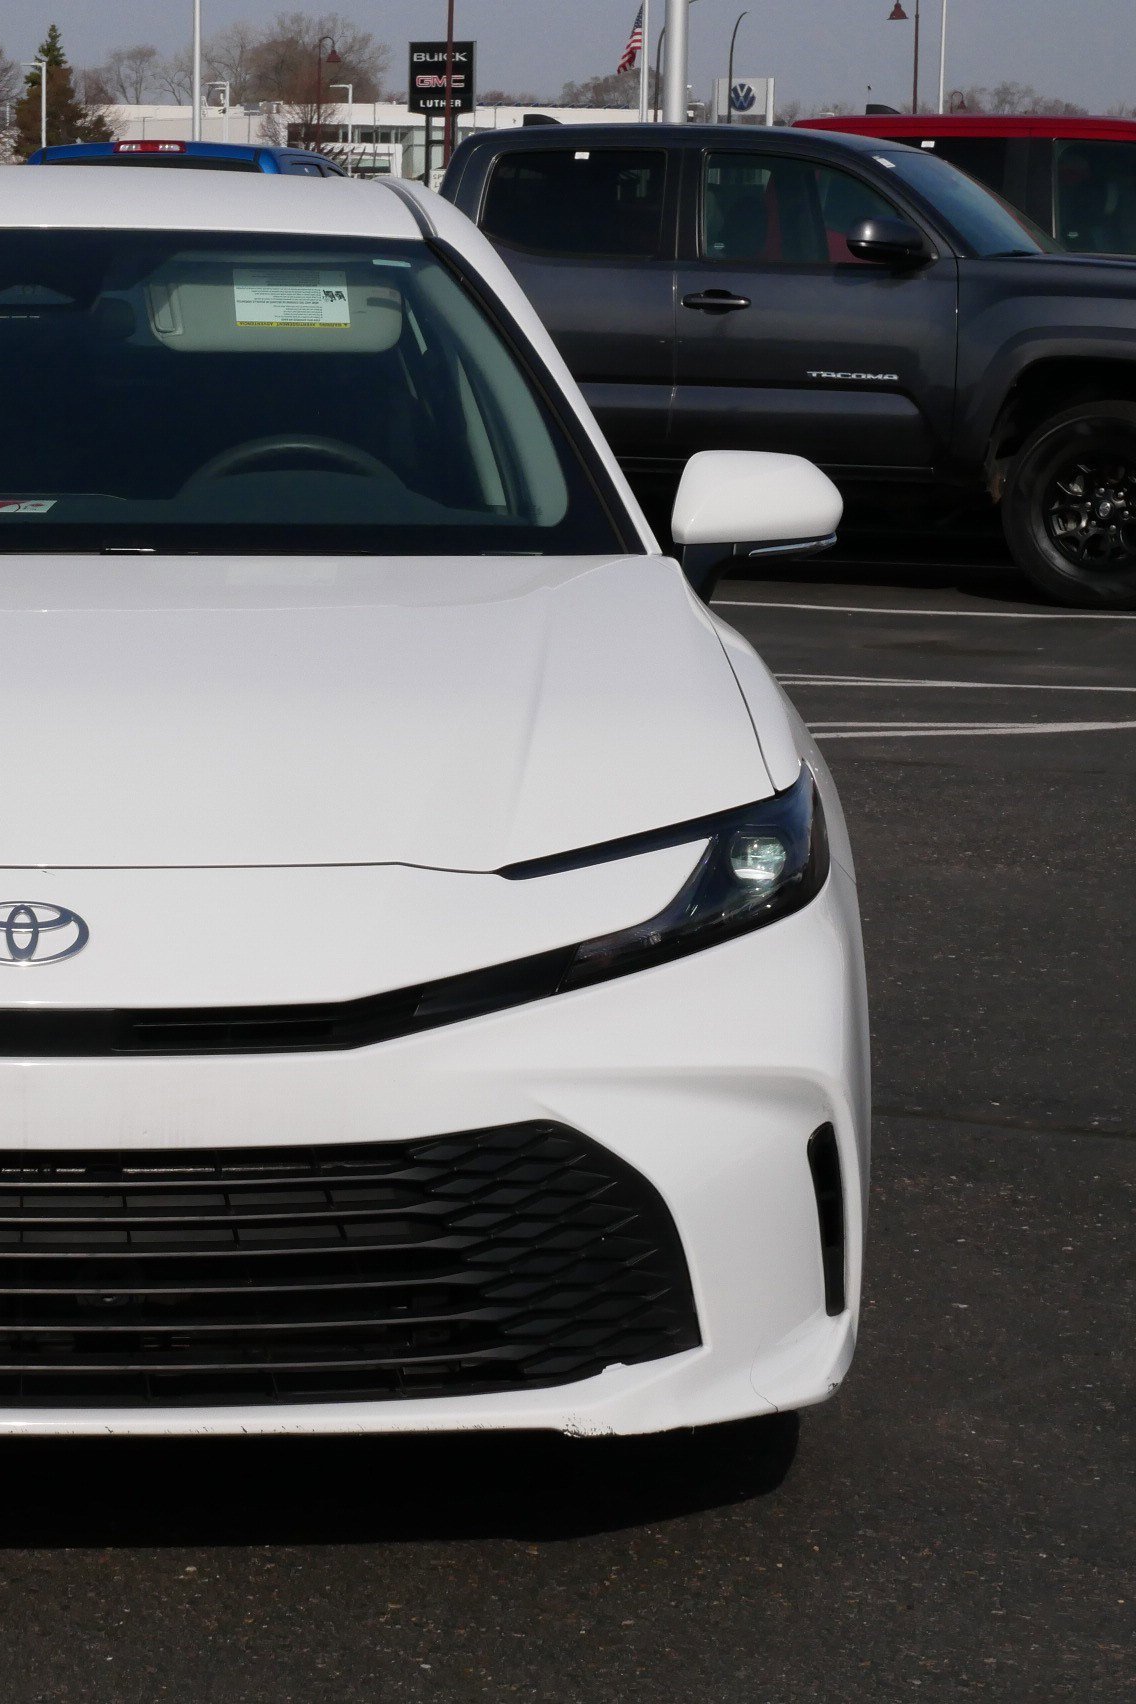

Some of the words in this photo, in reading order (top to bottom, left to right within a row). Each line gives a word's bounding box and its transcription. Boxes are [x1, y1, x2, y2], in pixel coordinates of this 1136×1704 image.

[413, 52, 468, 62] BUICK
[415, 74, 465, 88] GMC
[806, 371, 899, 381] TACOMA
